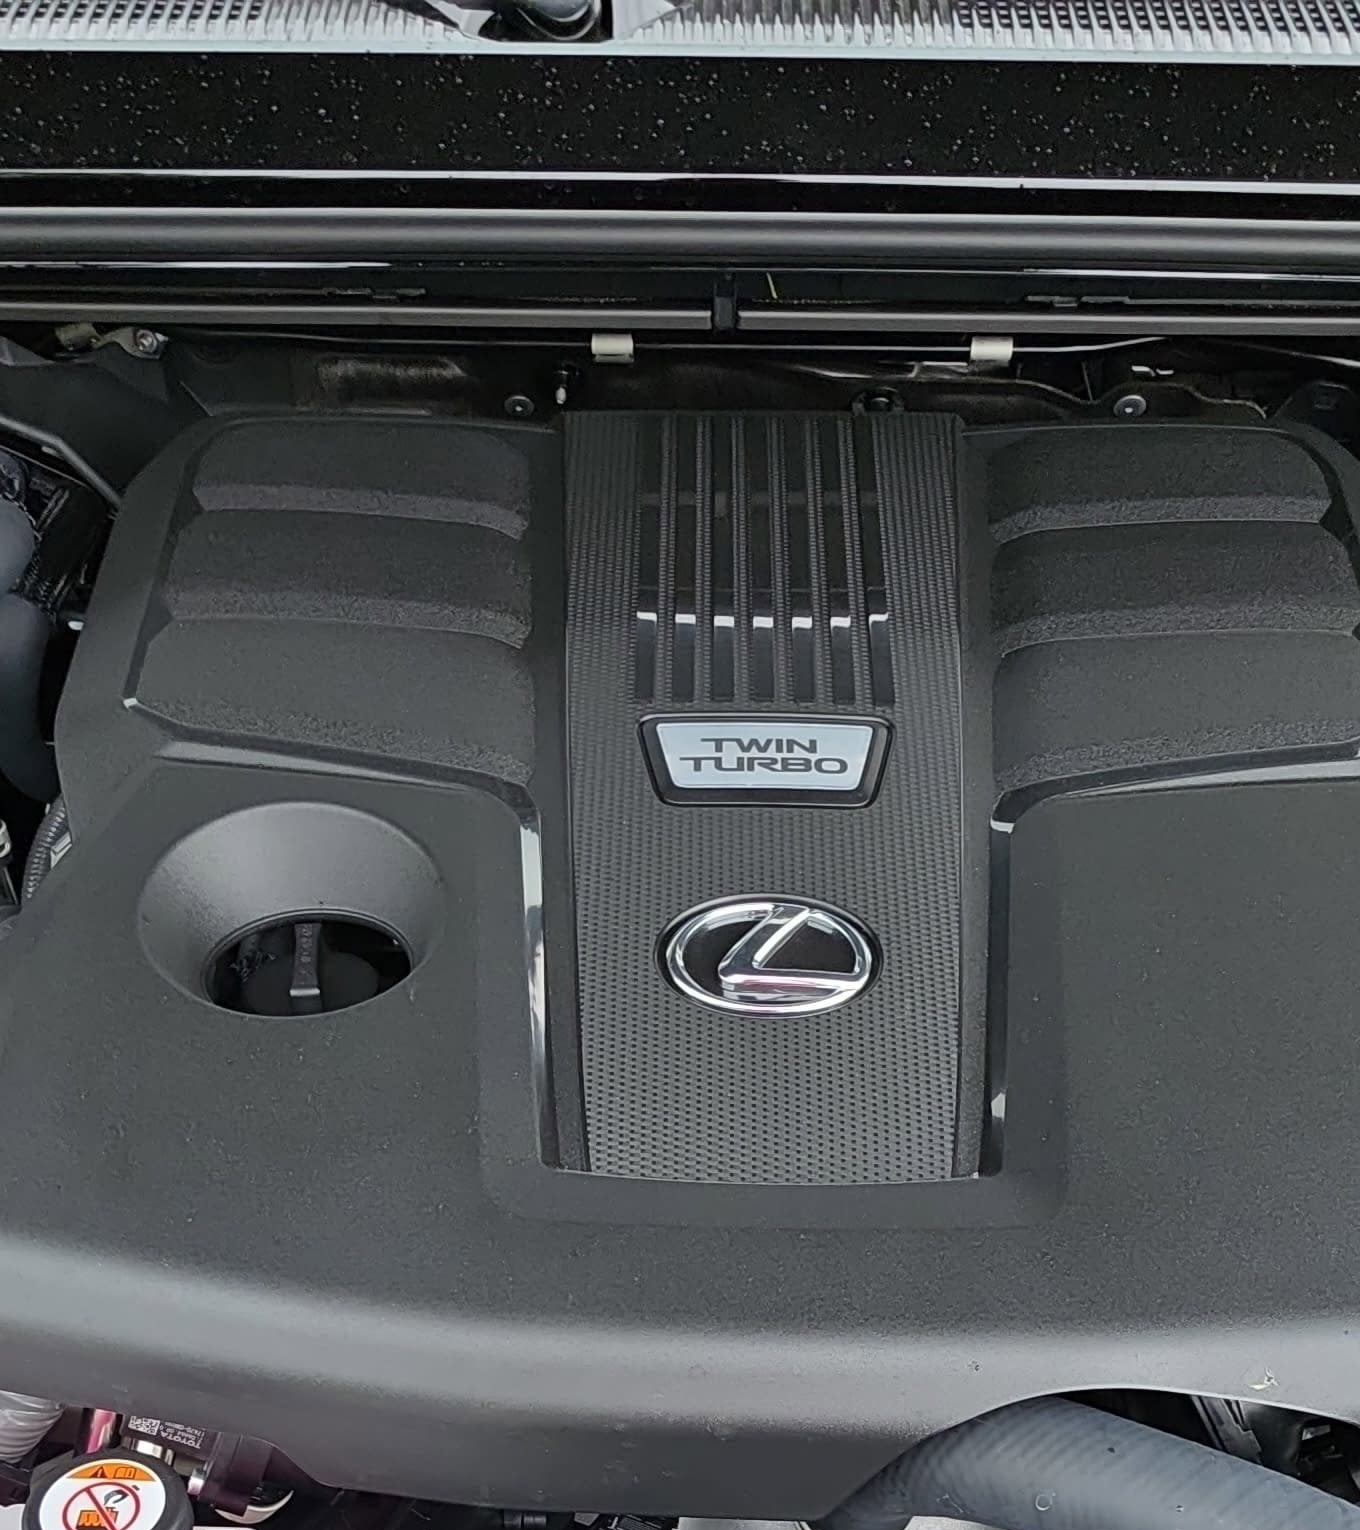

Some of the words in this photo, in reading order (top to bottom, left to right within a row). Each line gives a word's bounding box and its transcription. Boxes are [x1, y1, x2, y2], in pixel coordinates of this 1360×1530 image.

[701, 738, 818, 754] TWIN
[679, 757, 849, 775] TURBO
[160, 1430, 202, 1449] TOYOTA
